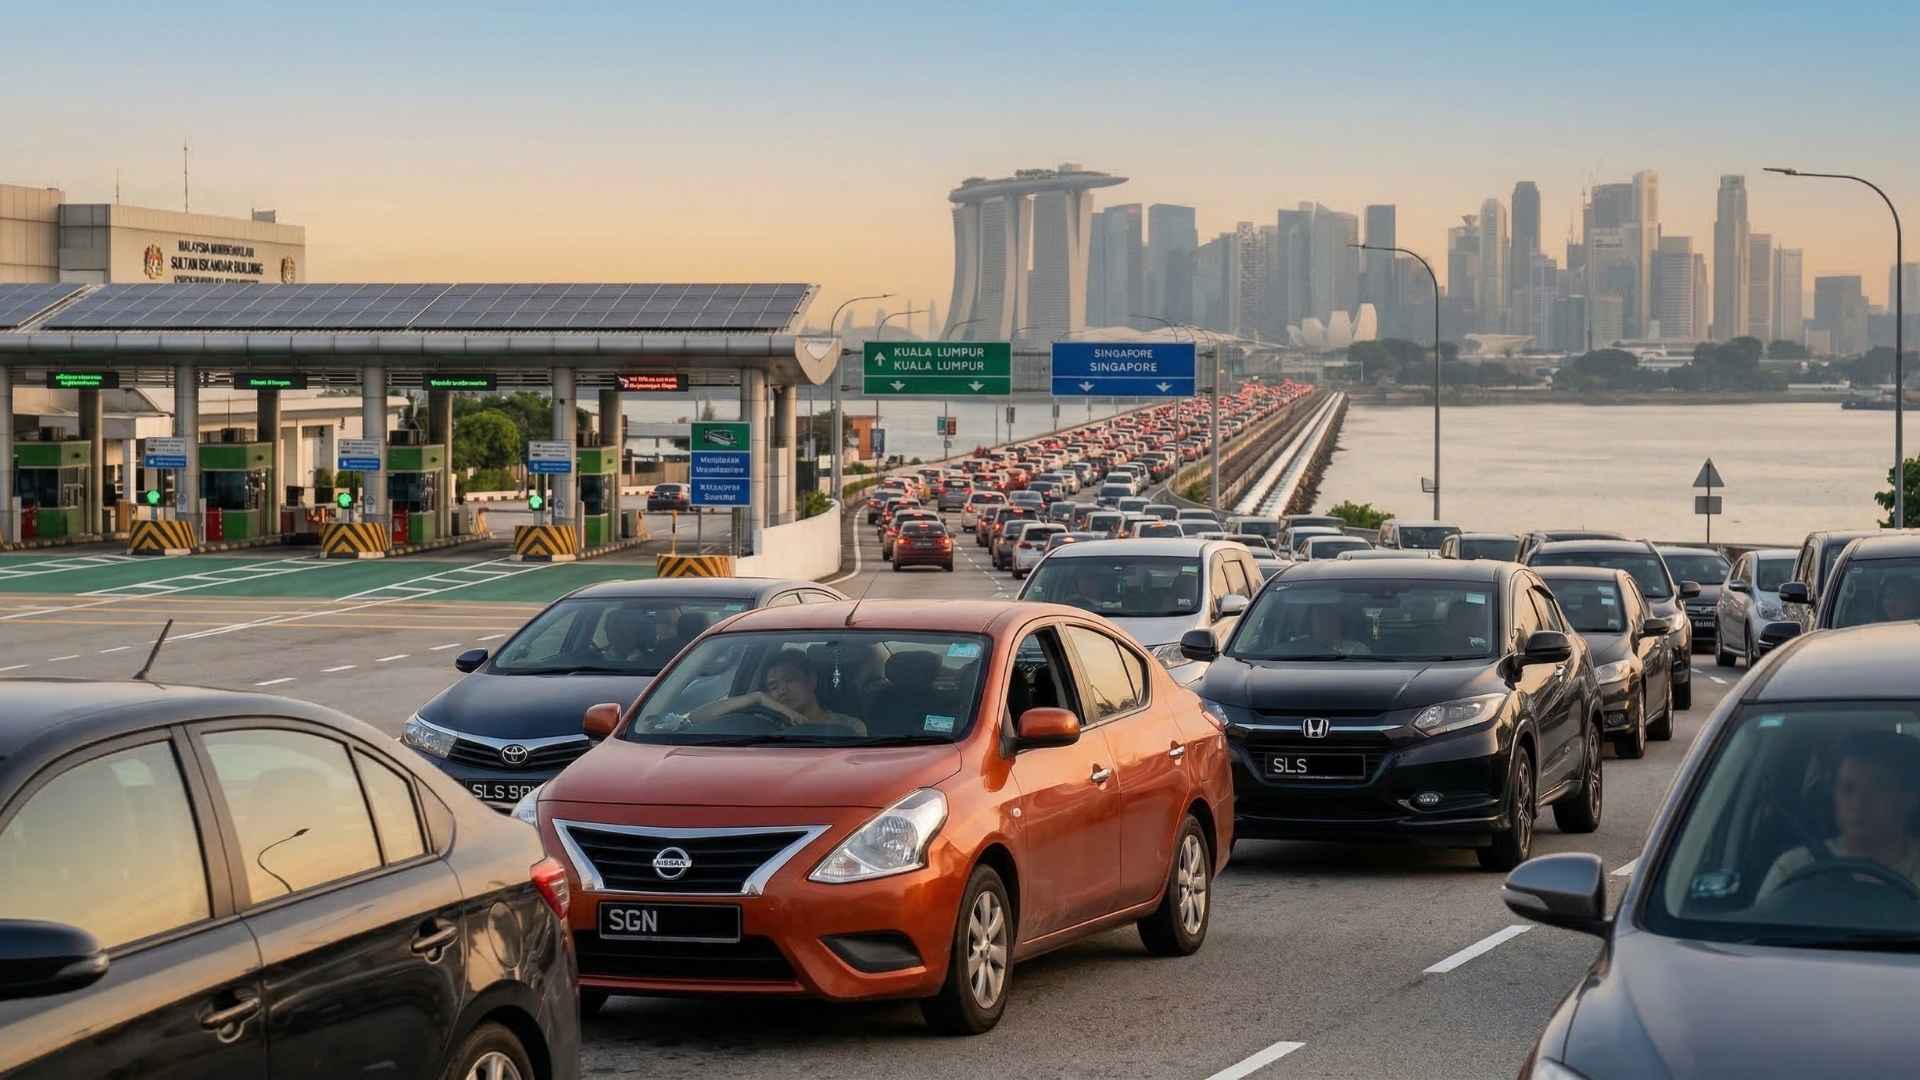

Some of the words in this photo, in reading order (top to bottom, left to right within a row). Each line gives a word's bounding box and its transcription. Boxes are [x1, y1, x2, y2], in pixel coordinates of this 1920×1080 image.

[171, 256, 198, 270] SULTAN
[199, 258, 233, 273] ISKANDAR
[234, 261, 264, 276] BUILDING
[894, 347, 932, 357] KUALA
[937, 347, 984, 357] LUMPUR
[1094, 349, 1153, 359] SINGAPORE
[894, 361, 932, 371] KUALA
[937, 361, 984, 371] LUMPUR
[1090, 362, 1158, 373] SINGAPORE
[1273, 757, 1308, 773] SLS
[472, 784, 505, 799] SLS
[655, 859, 686, 867] NISSAN
[609, 909, 657, 932] SGN
